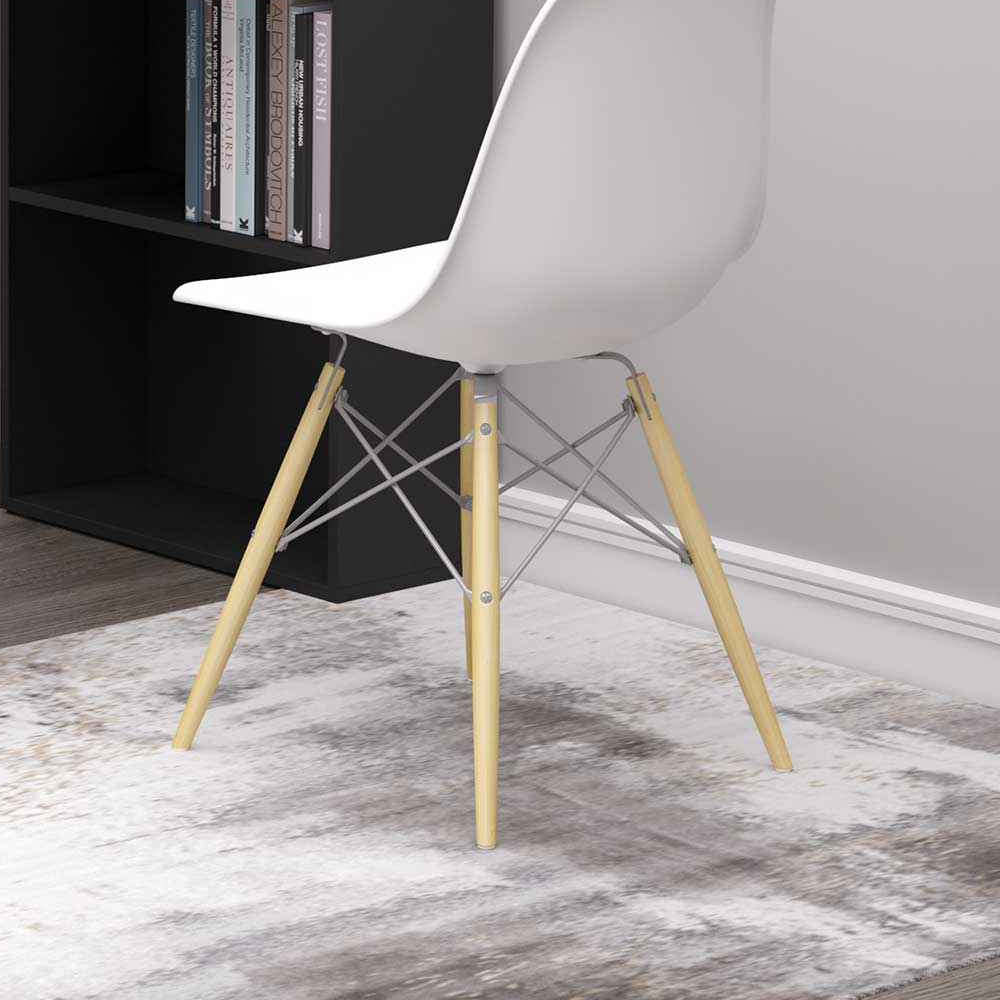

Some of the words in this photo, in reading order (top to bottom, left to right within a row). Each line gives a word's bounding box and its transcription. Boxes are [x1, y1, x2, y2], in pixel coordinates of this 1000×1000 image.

[271, 3, 284, 85] ALEXEY
[316, 20, 327, 72] LOST
[224, 55, 234, 171] ANTIQUAIRES
[316, 76, 327, 121] FISH
[270, 91, 283, 225] BRODOVITCH
